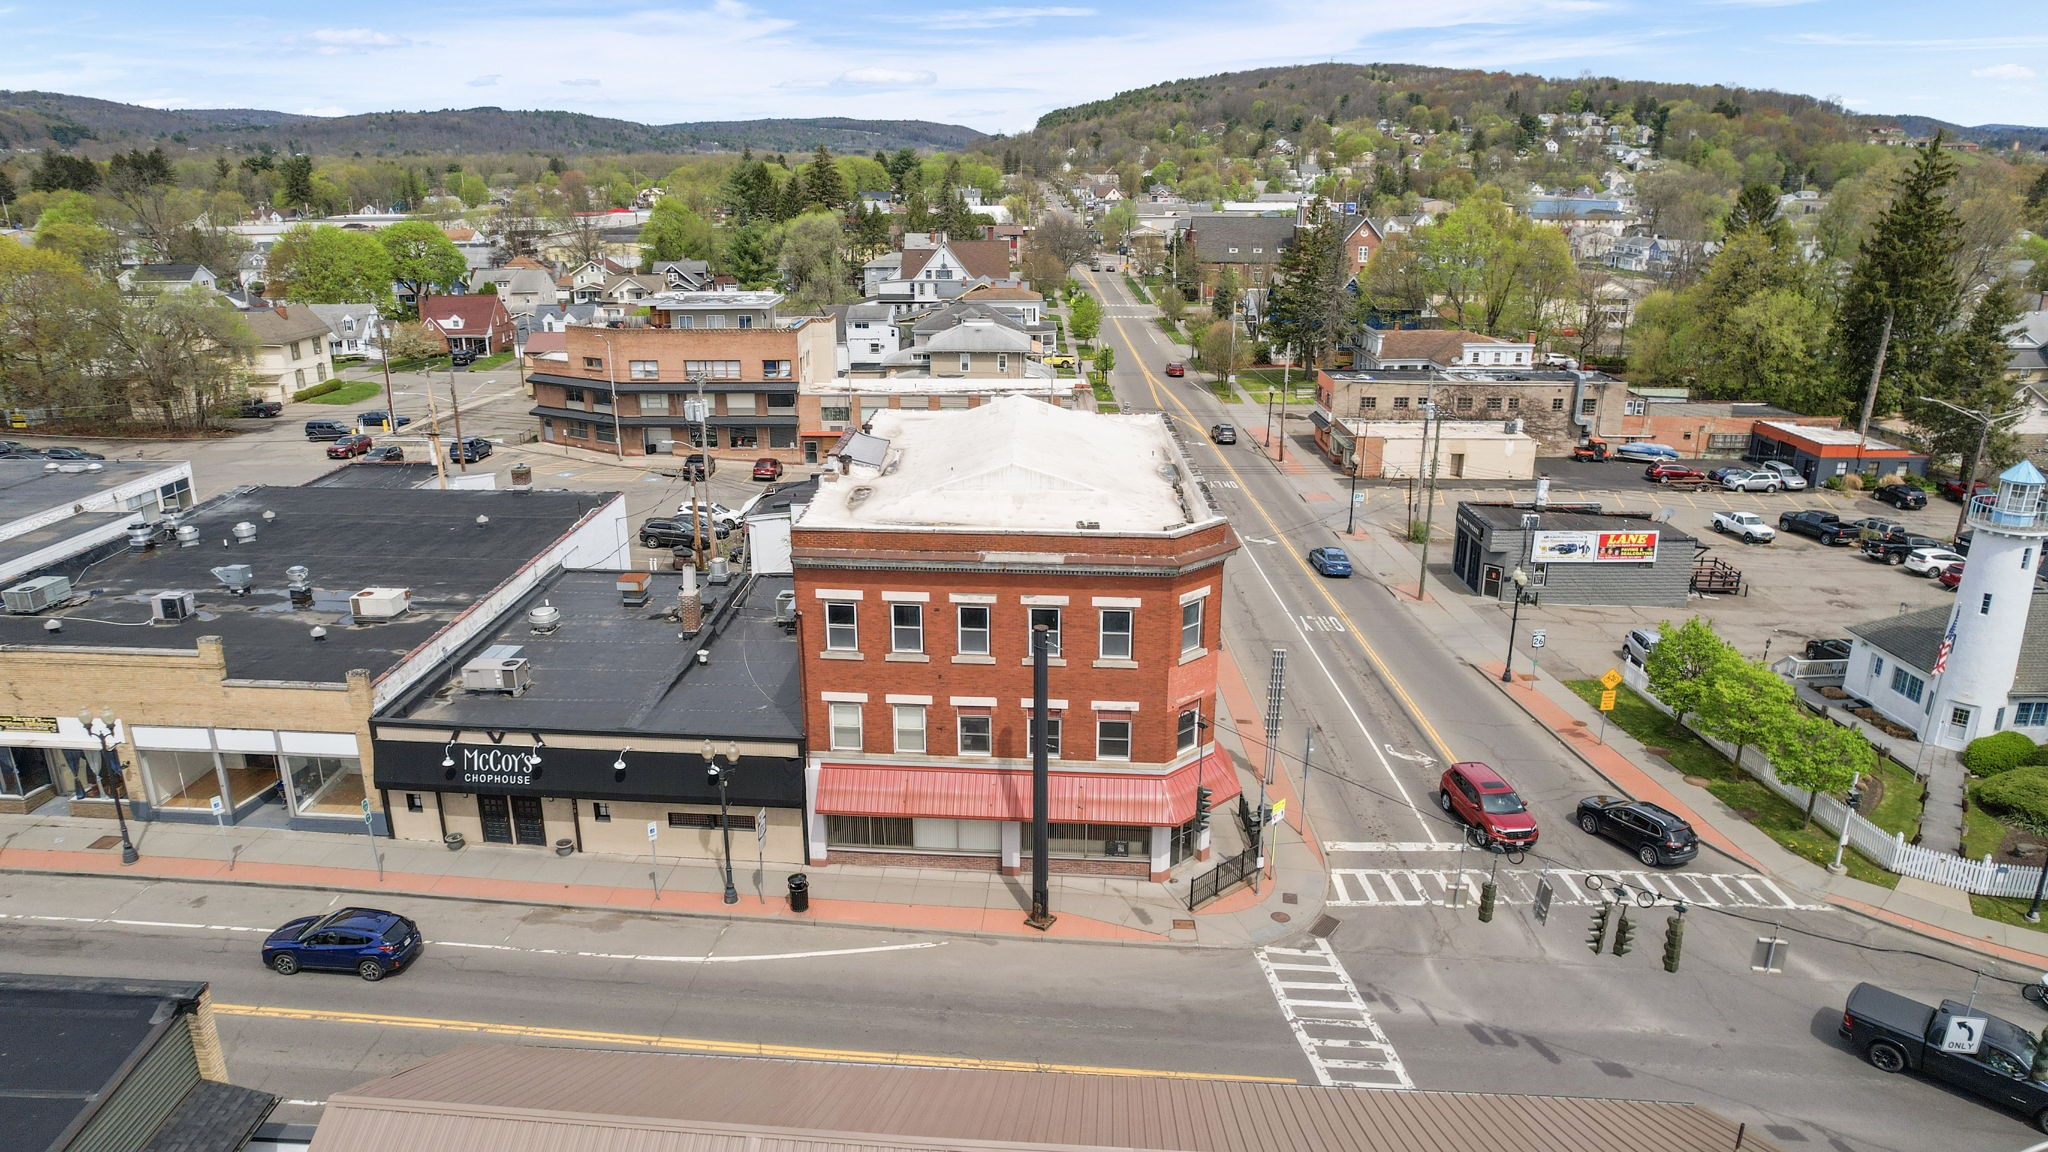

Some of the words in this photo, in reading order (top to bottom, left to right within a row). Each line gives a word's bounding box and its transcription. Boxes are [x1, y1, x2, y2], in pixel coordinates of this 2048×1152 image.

[1209, 480, 1239, 489] ONLY
[1607, 534, 1649, 545] LANE
[1299, 615, 1346, 632] ONLY
[1533, 637, 1544, 646] 26
[464, 773, 531, 785] CHOPHOUSE
[1947, 1041, 1975, 1050] ONLY
